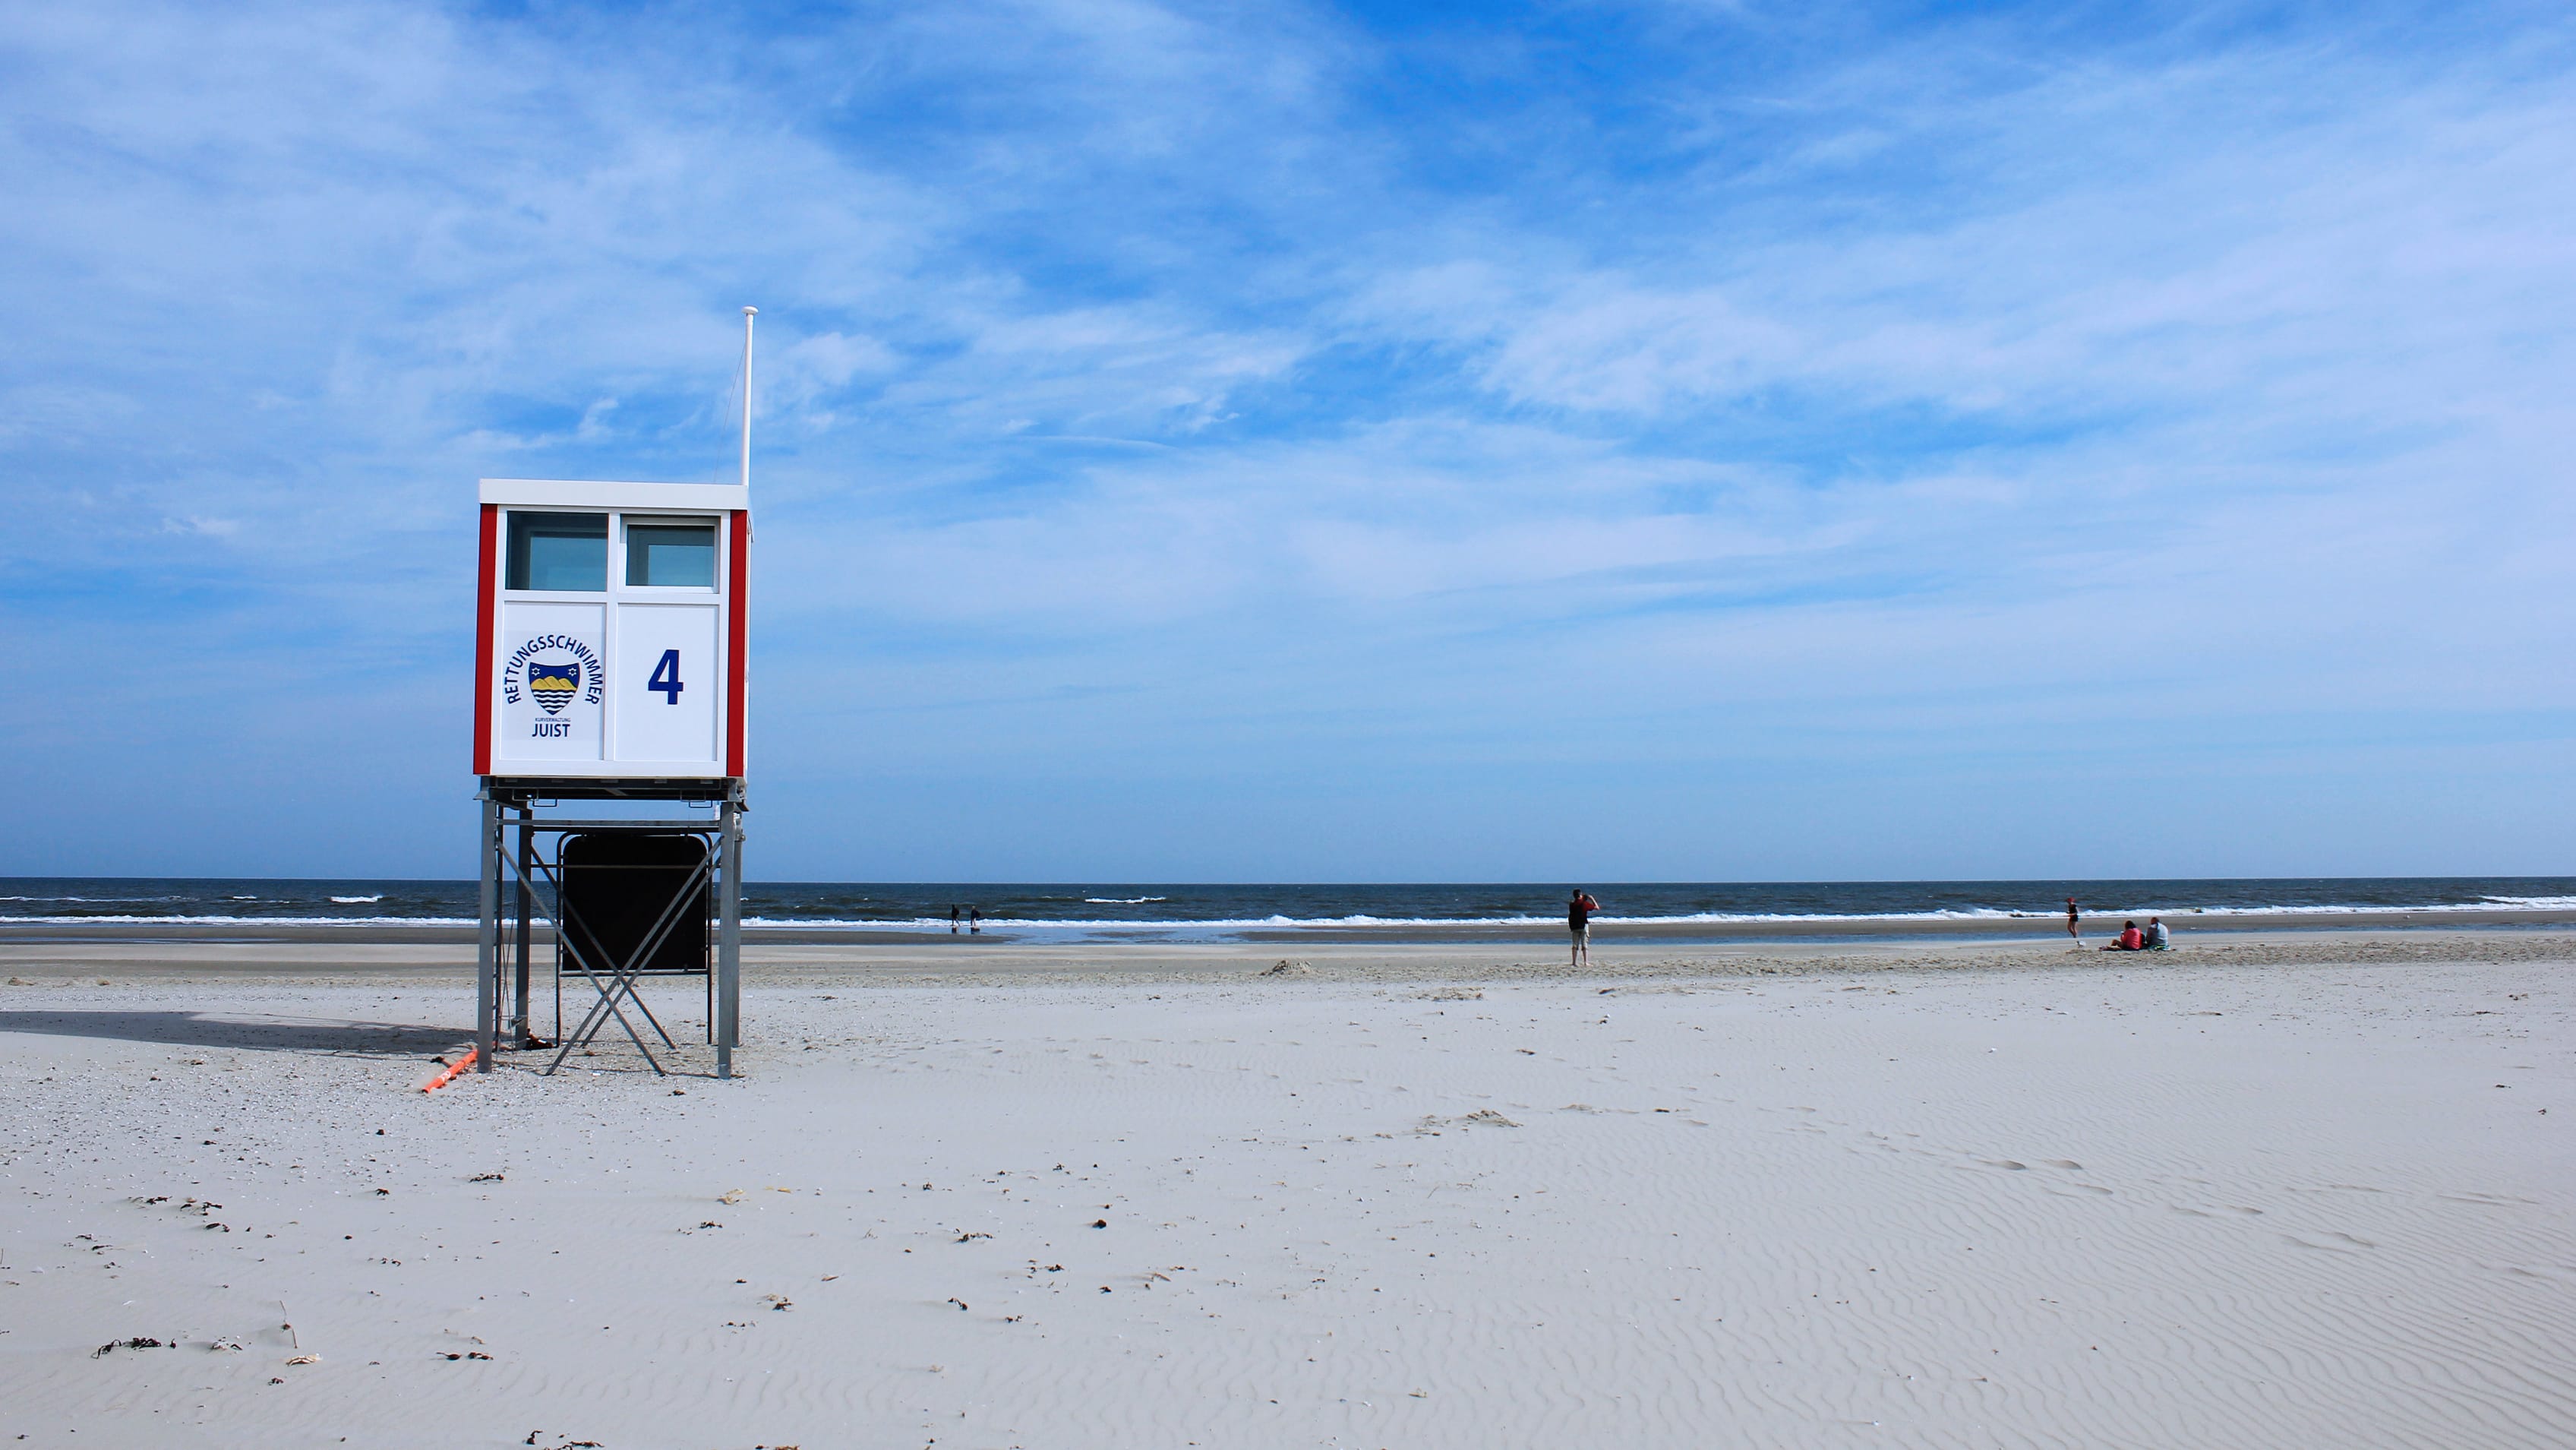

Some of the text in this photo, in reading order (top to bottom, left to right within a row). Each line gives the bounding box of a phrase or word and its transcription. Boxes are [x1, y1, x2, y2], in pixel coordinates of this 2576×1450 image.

[504, 634, 604, 705] RETTUNGSSCHWIMMER
[648, 649, 684, 706] 4
[532, 723, 571, 738] JUIST
